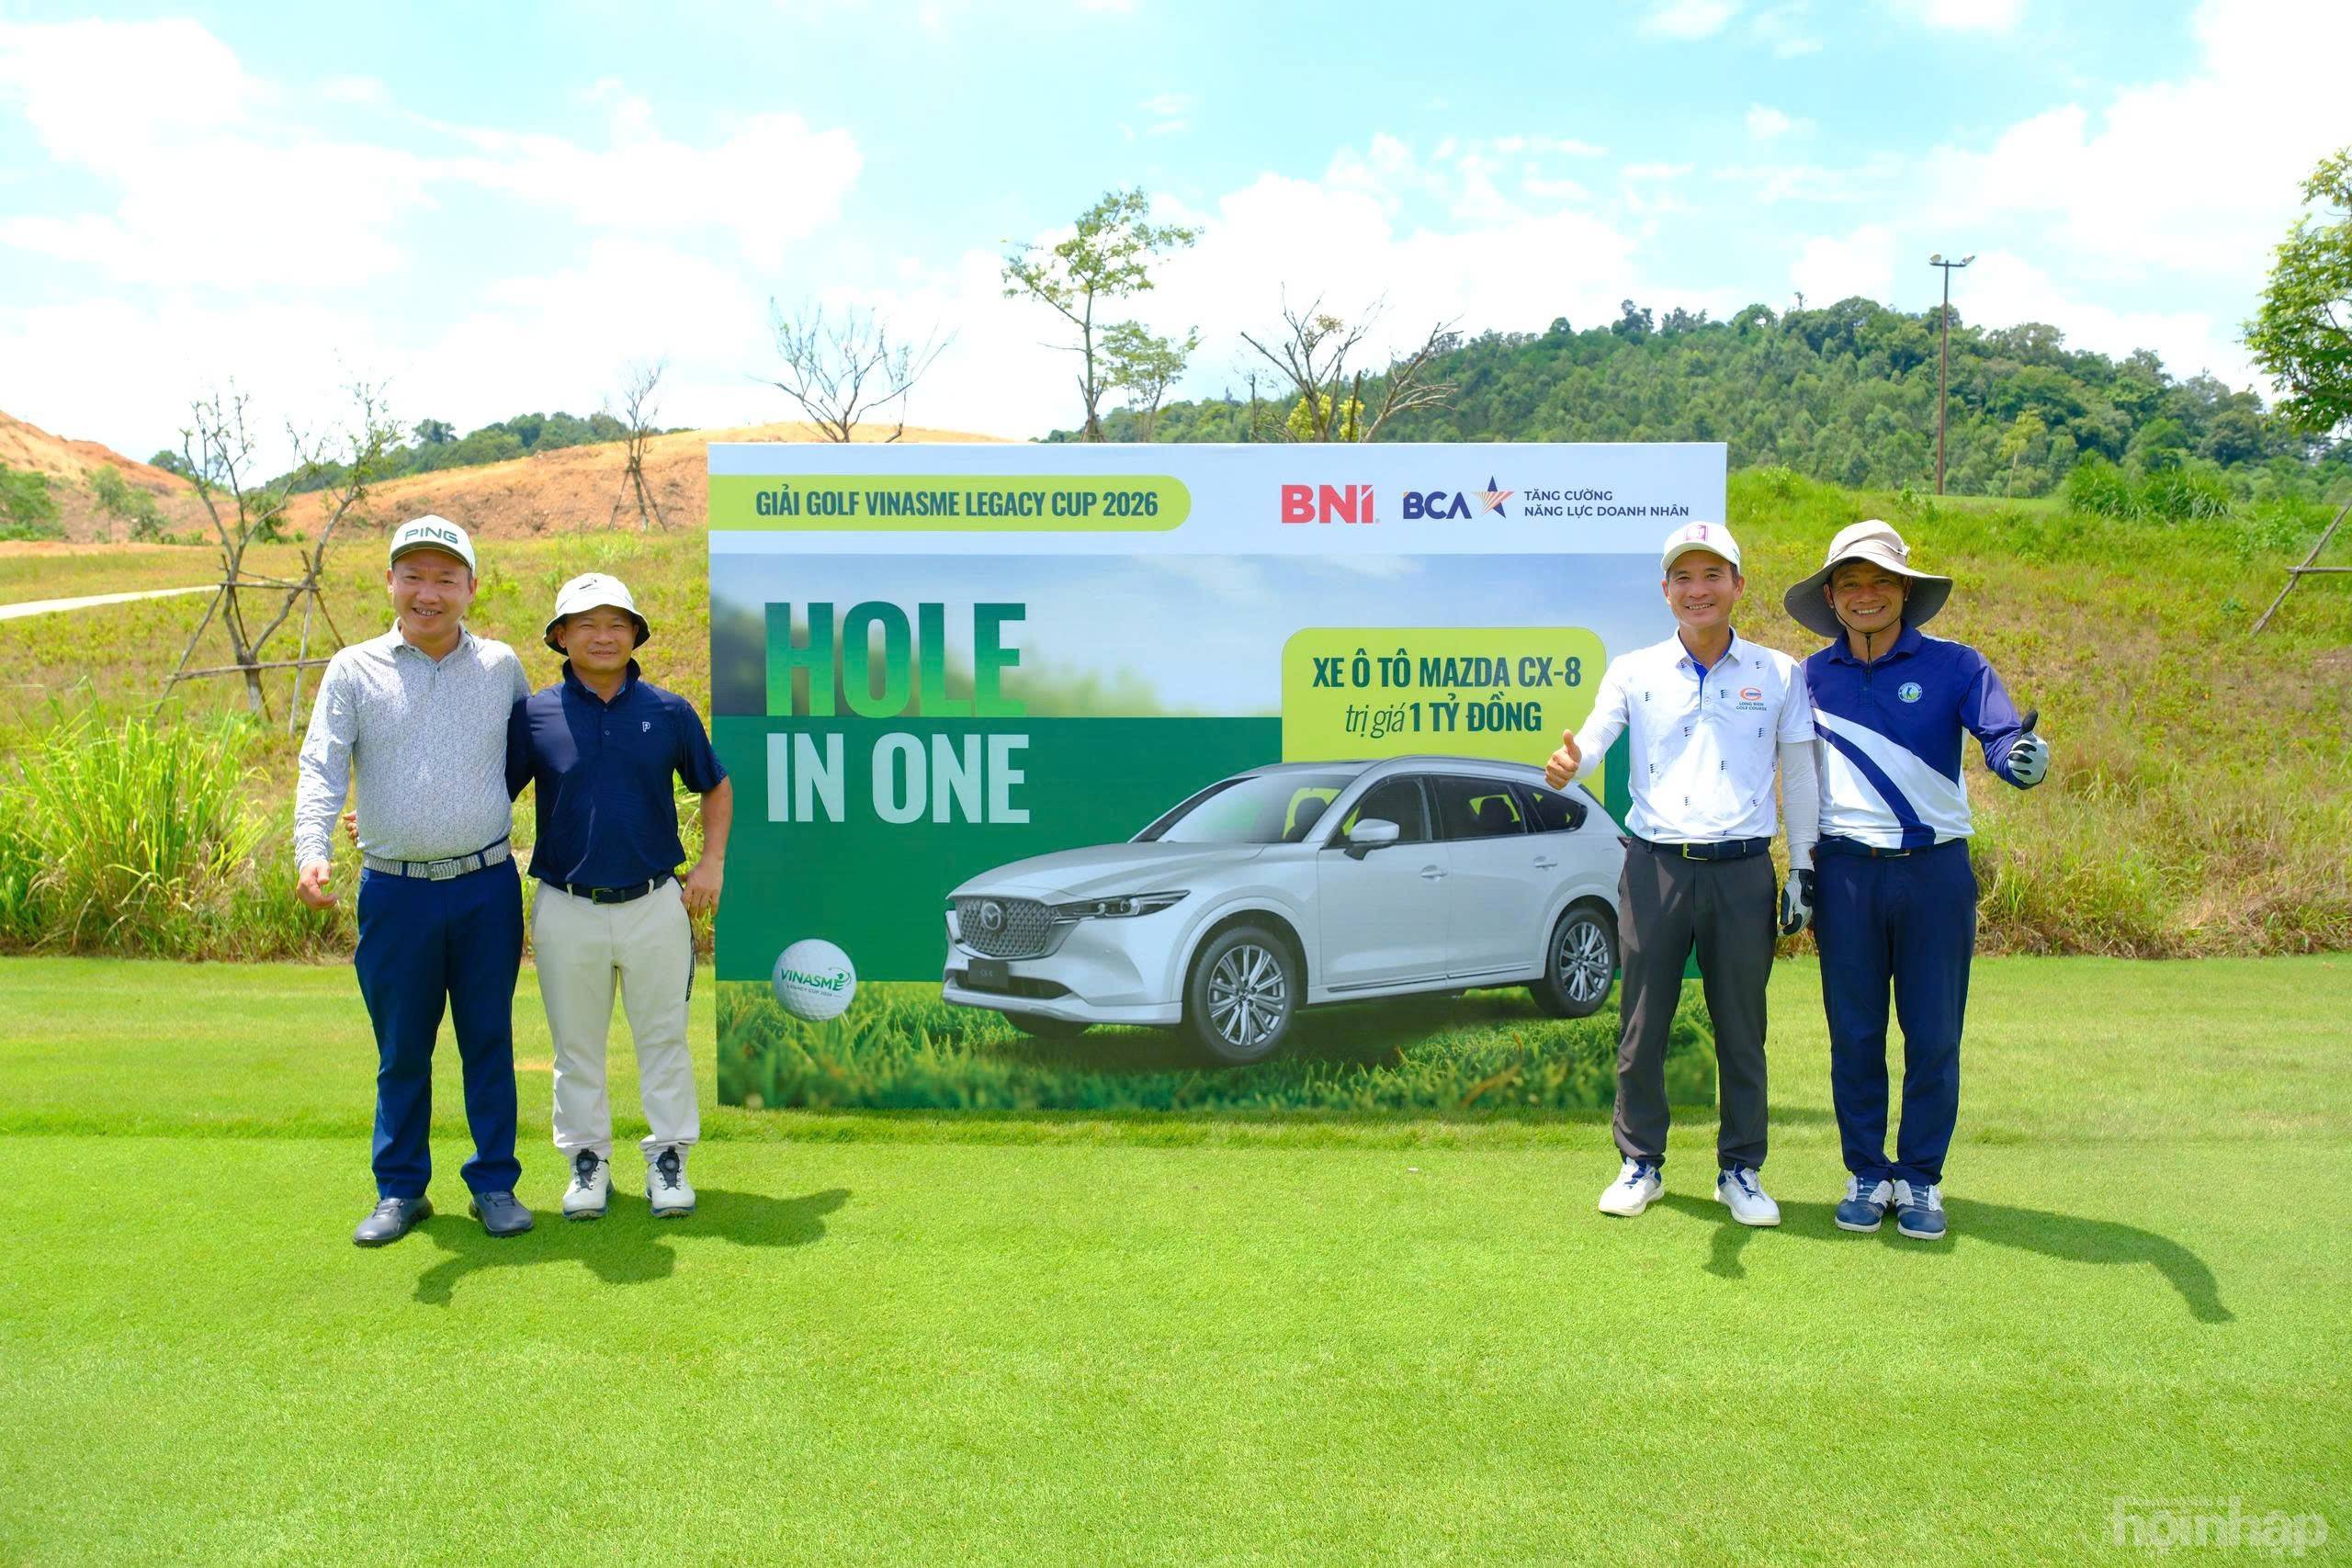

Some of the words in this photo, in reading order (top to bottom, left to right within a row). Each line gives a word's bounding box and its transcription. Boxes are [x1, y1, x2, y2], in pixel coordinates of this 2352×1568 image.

[755, 484, 799, 516] GIẢI
[806, 491, 860, 516] GOLF
[865, 491, 960, 516] VINASME
[966, 491, 1046, 516] LEGACY
[1051, 491, 1096, 516] CUP
[1102, 491, 1159, 516] 2026
[1403, 491, 1473, 520] BCA
[1524, 490, 1561, 502] TĂNG
[1564, 490, 1613, 502] CƯỜNG
[1524, 504, 1563, 517] NĂNG
[1566, 505, 1593, 519] LỰC
[1597, 505, 1647, 517] DOANH
[1650, 503, 1690, 517] NHÂN
[404, 526, 458, 545] PING
[764, 601, 1027, 718] HOLE
[1312, 657, 1345, 688] XE
[1351, 648, 1371, 688] Ô
[1377, 648, 1411, 688] TÔ
[1419, 657, 1510, 687] MAZDA
[1518, 657, 1581, 687] CX-8
[1344, 704, 1368, 737] trị
[1370, 702, 1407, 739] giá
[1409, 702, 1420, 732] 1
[1429, 693, 1460, 732] TỶ
[1465, 691, 1542, 732] ĐỒNG
[766, 733, 845, 823] IN
[872, 732, 1030, 824] ONE
[781, 968, 844, 991] VINASME
